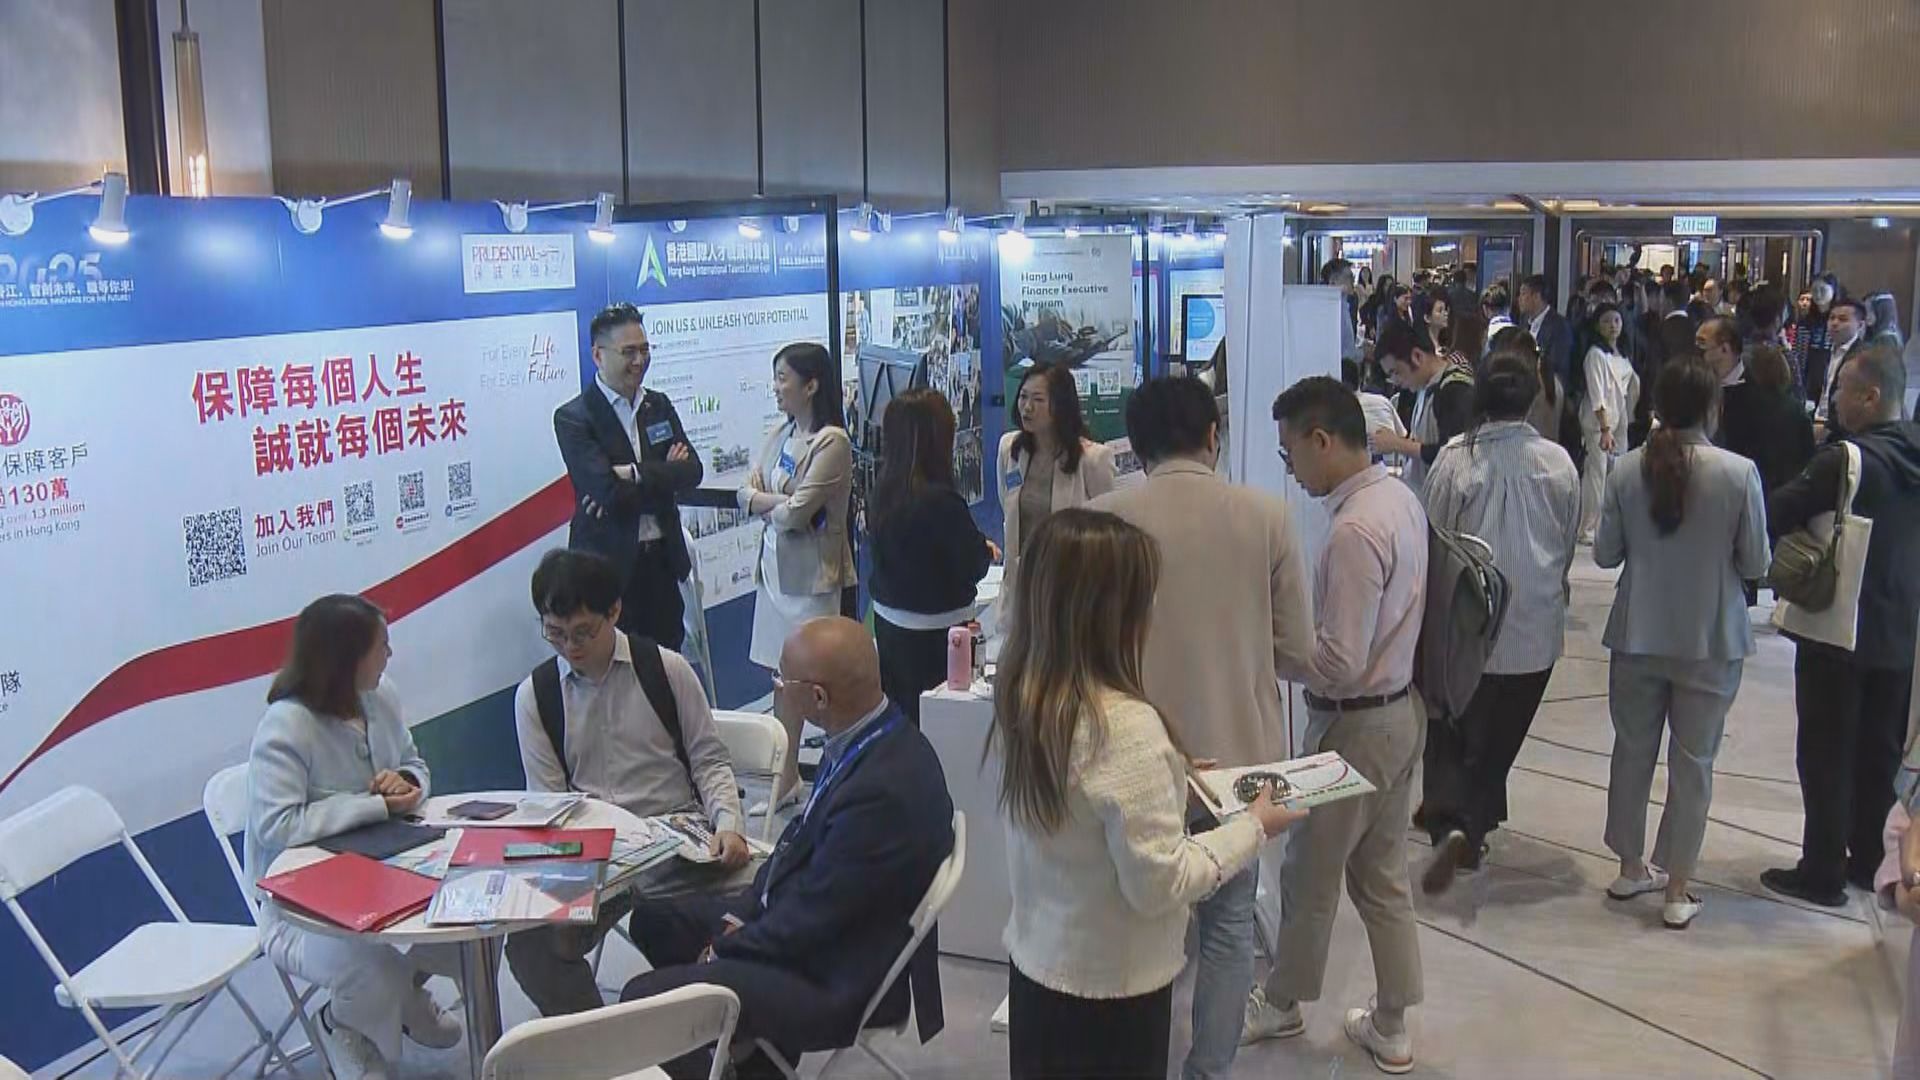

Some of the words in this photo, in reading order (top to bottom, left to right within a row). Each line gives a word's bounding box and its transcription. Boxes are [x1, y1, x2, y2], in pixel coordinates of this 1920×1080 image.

[1049, 271, 1074, 282] Lung
[1021, 285, 1060, 297] Finance
[1062, 282, 1109, 295] Executive
[650, 320, 674, 335] JOIN
[676, 318, 689, 332] US
[698, 315, 741, 331] UNLEASH
[743, 311, 769, 327] YOUR
[768, 307, 809, 325] POTENTIAL
[528, 360, 567, 383] Future
[192, 350, 427, 425] 保障每個人生
[252, 397, 468, 477] 誠就每個未來
[50, 502, 86, 517] million
[254, 500, 335, 538] 加入我們
[14, 528, 23, 539] in
[55, 518, 80, 533] Kong
[256, 540, 279, 557] Join
[282, 535, 303, 551] Our
[305, 529, 336, 545] Team
